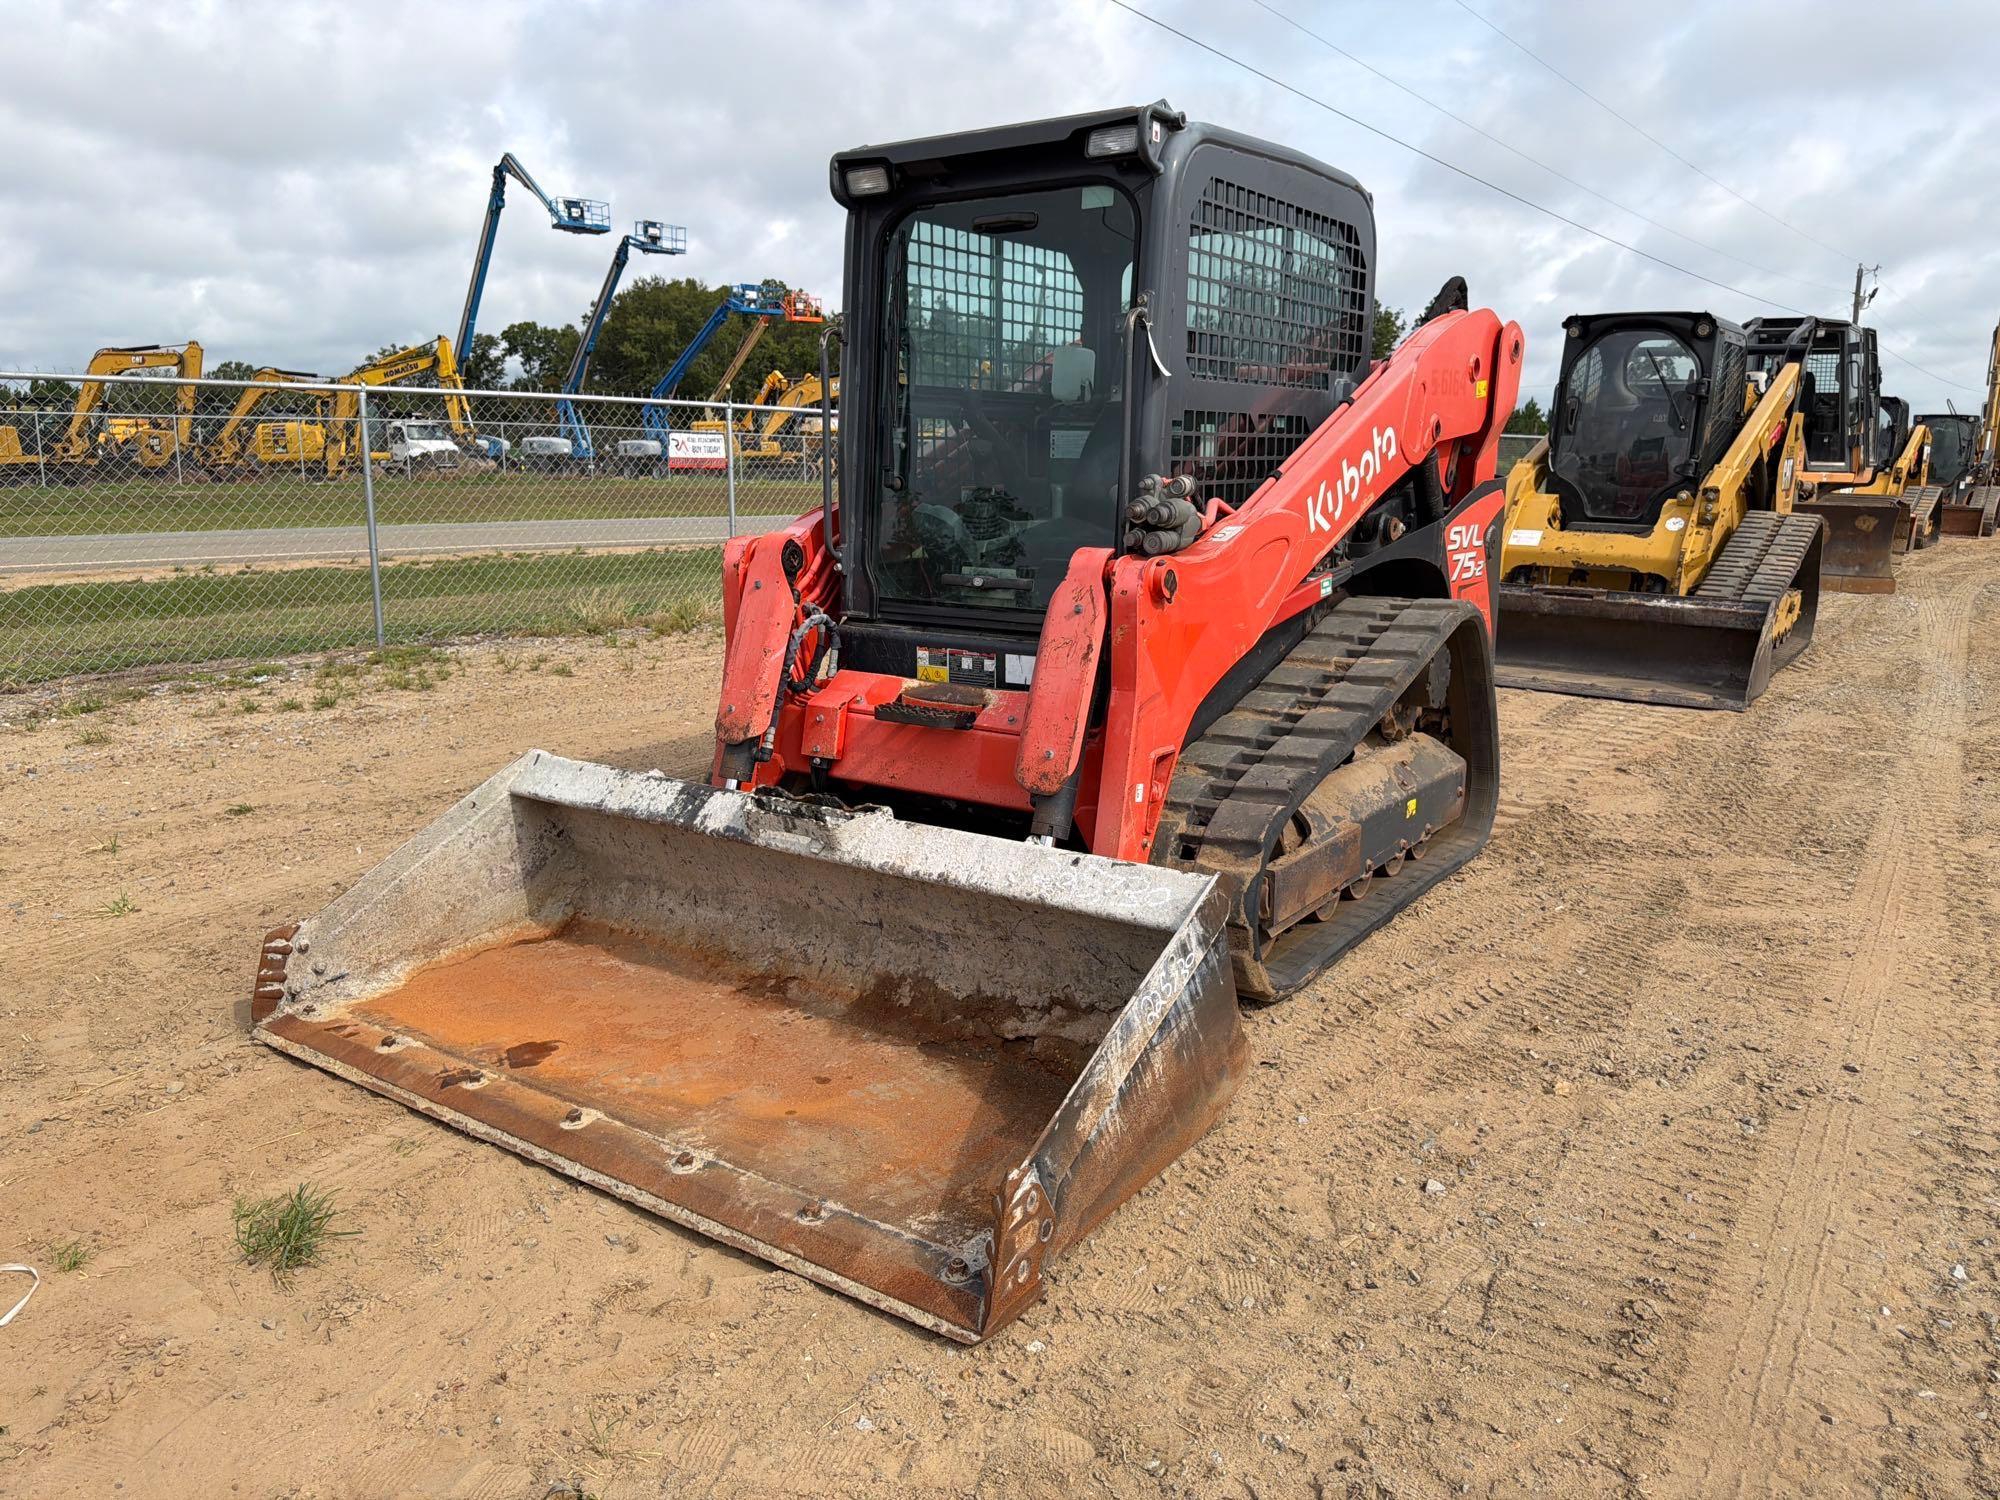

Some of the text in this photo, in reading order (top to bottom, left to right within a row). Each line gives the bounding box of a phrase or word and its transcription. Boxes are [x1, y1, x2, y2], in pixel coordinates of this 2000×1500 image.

[131, 355, 143, 364] CAT
[383, 361, 419, 379] KOMATSU
[1306, 426, 1397, 534] Kubota
[1447, 524, 1484, 551] SVL
